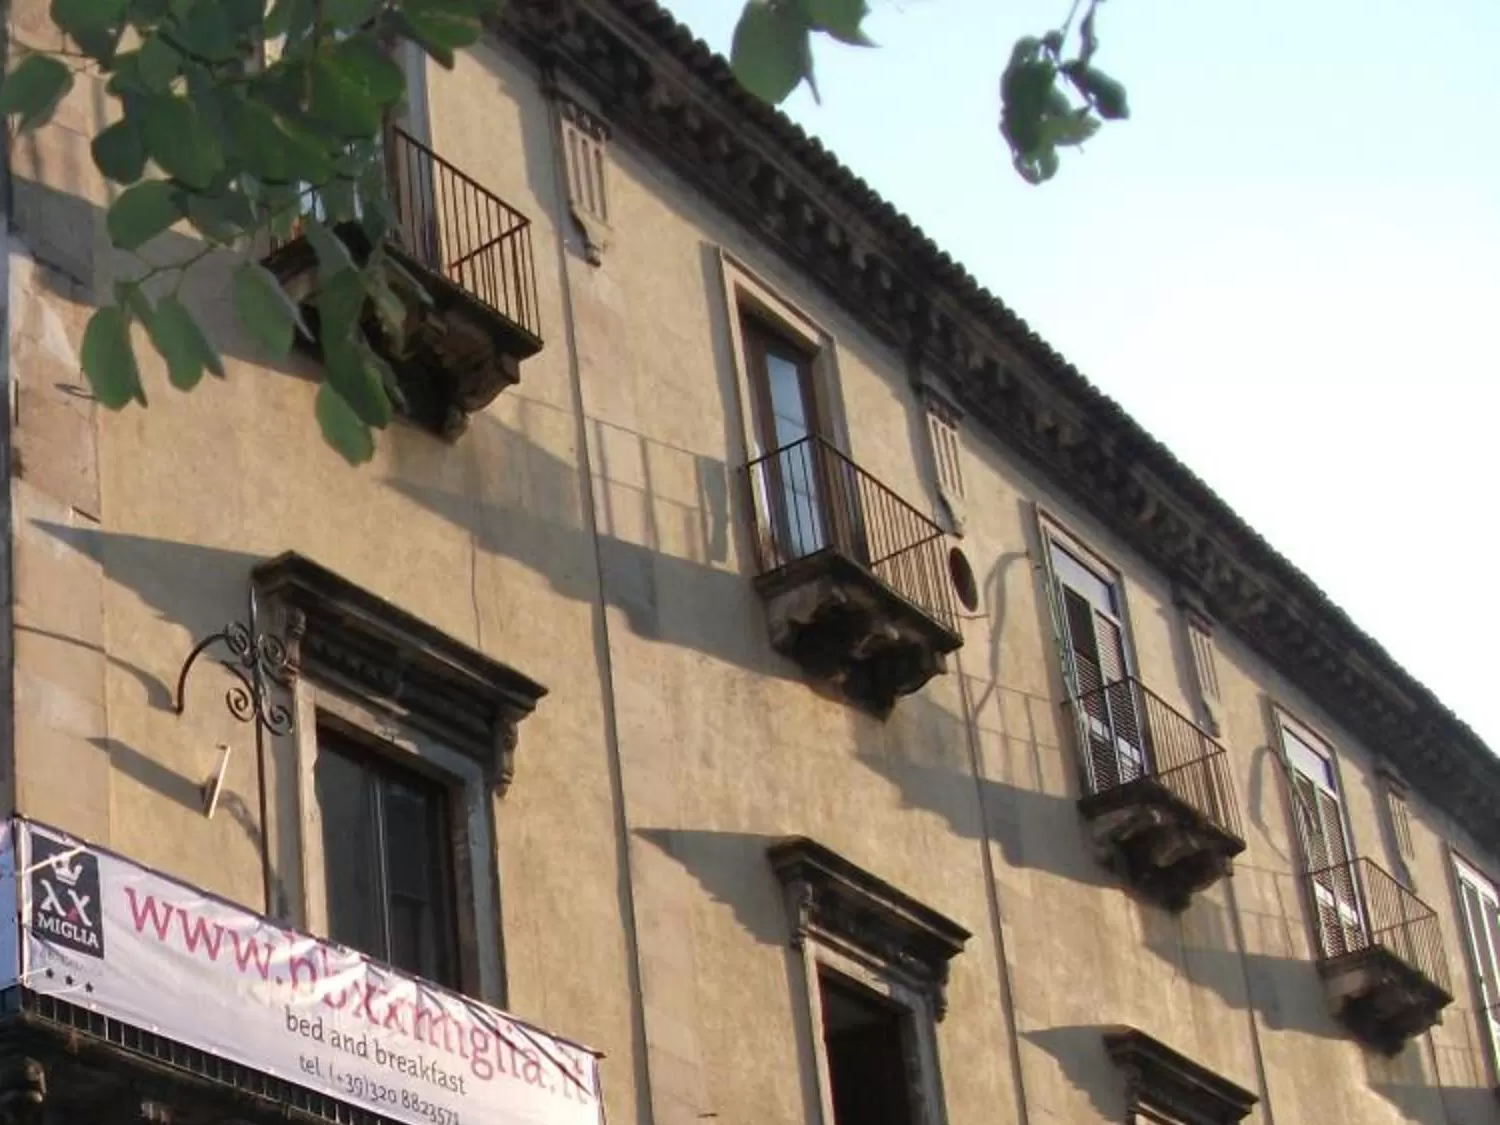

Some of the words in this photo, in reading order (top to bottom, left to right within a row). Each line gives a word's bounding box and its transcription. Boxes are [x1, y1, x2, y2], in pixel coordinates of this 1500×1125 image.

[37, 911, 99, 949] MIGLIA
[284, 1004, 325, 1043] bed
[330, 1028, 368, 1059] and
[373, 1038, 467, 1096] breakfast
